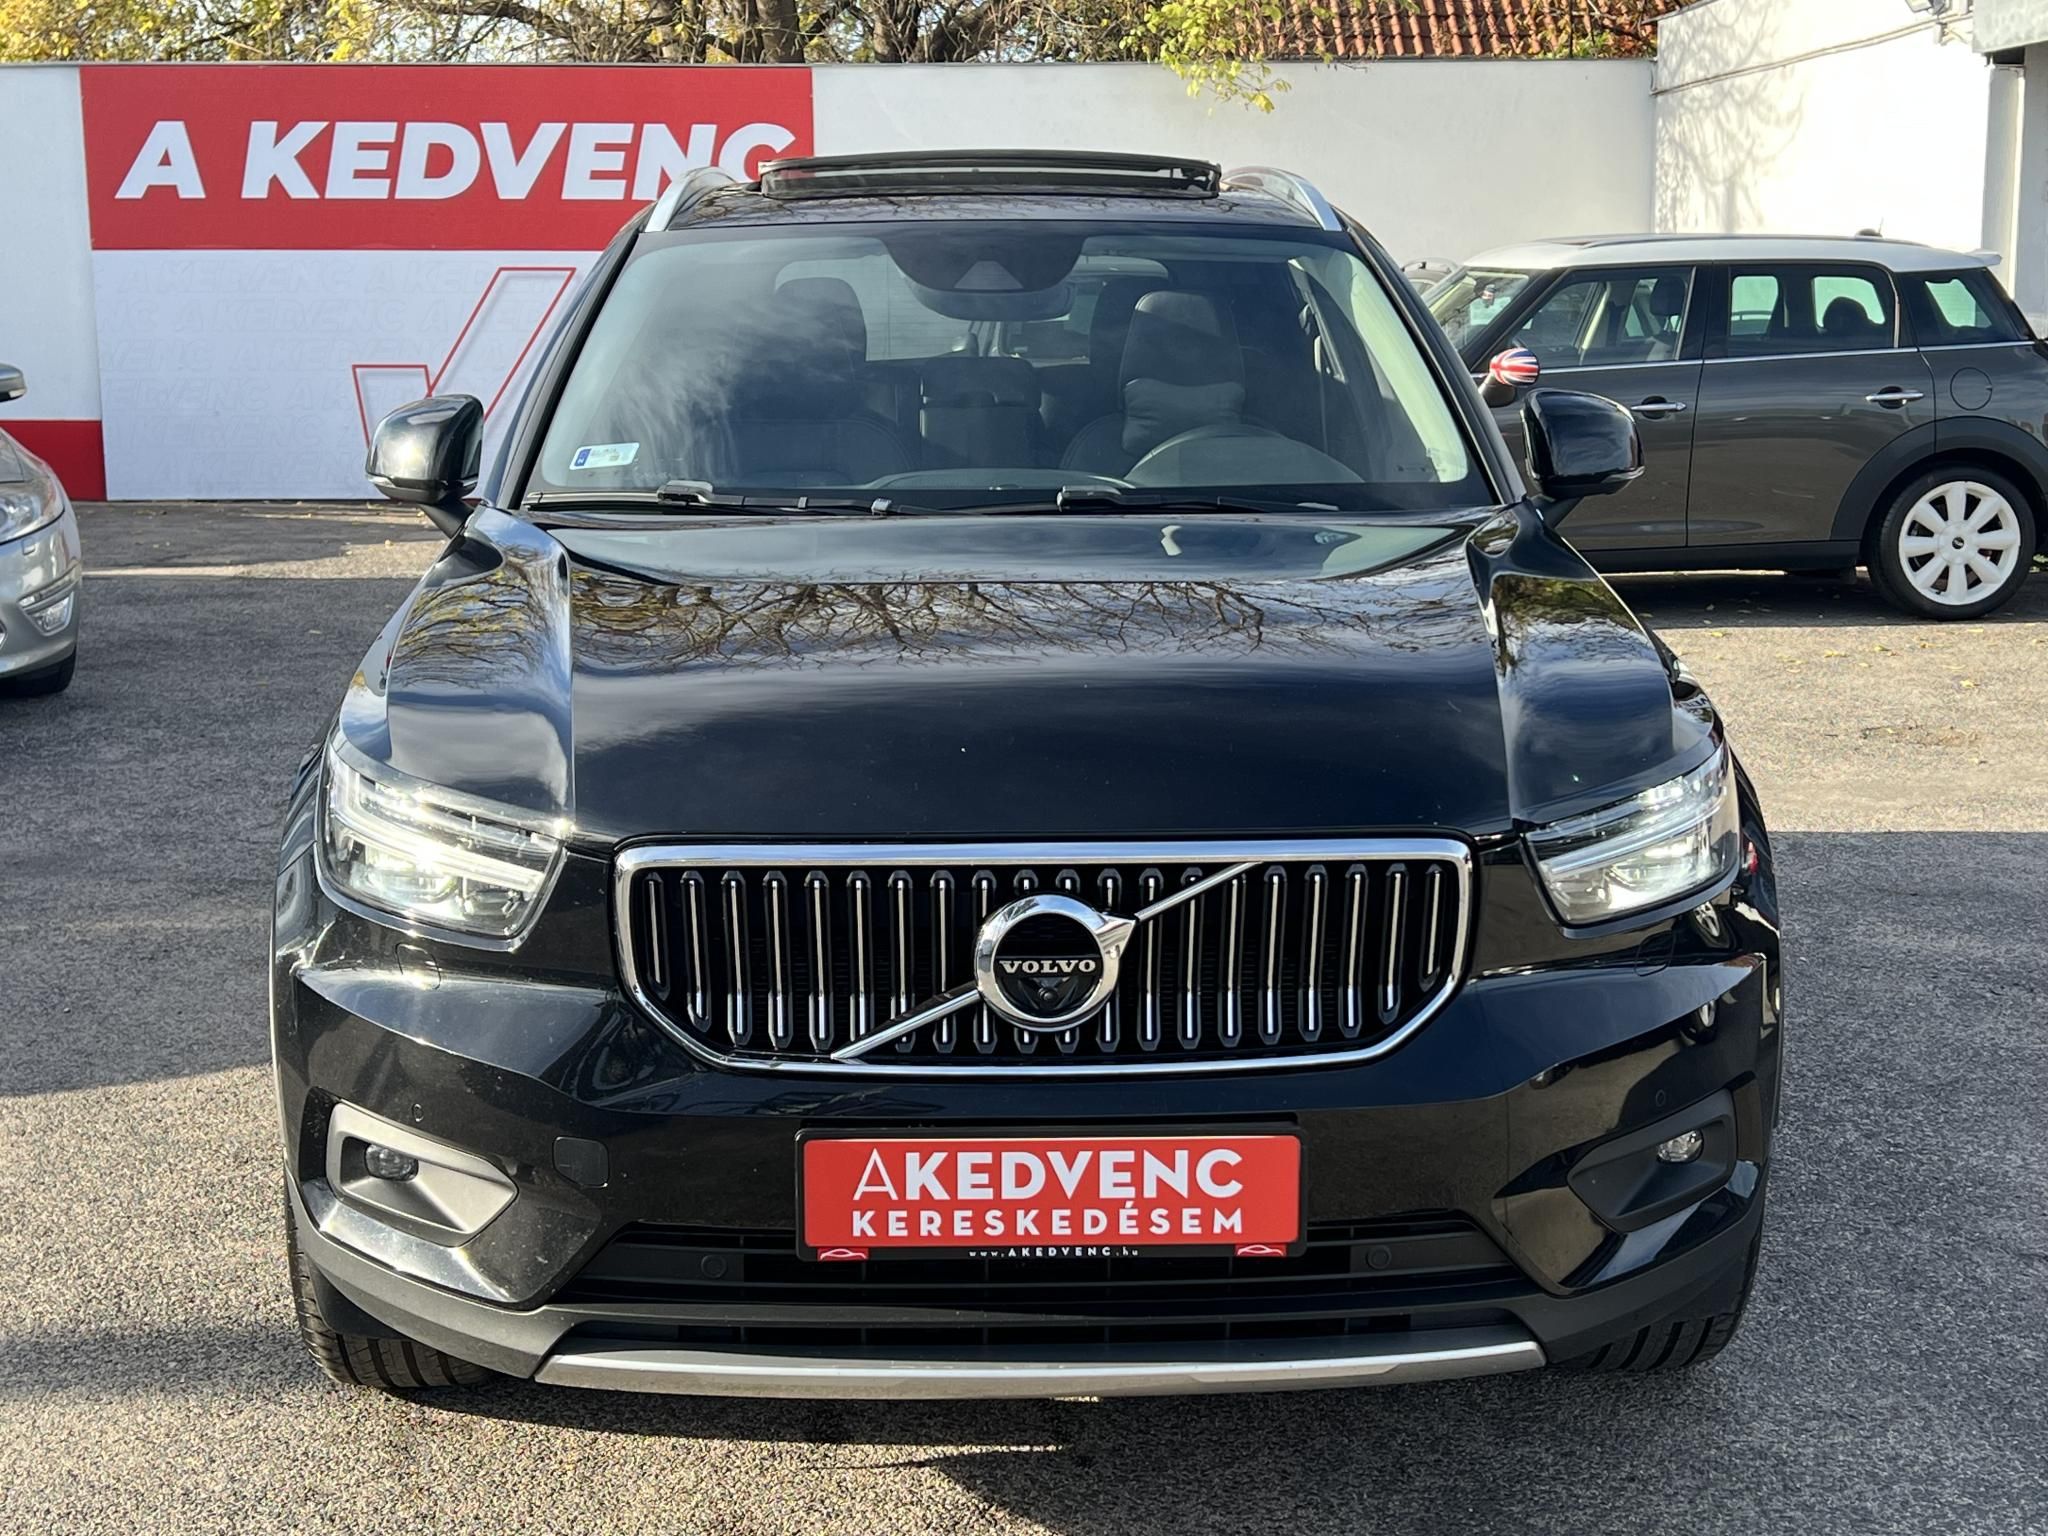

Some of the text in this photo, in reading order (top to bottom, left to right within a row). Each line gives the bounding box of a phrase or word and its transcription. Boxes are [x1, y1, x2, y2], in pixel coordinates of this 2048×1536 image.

[115, 121, 796, 200] A KEDVENC
[1000, 959, 1096, 974] VOLVO
[852, 1201, 1243, 1237] KERESKEDÉSEM
